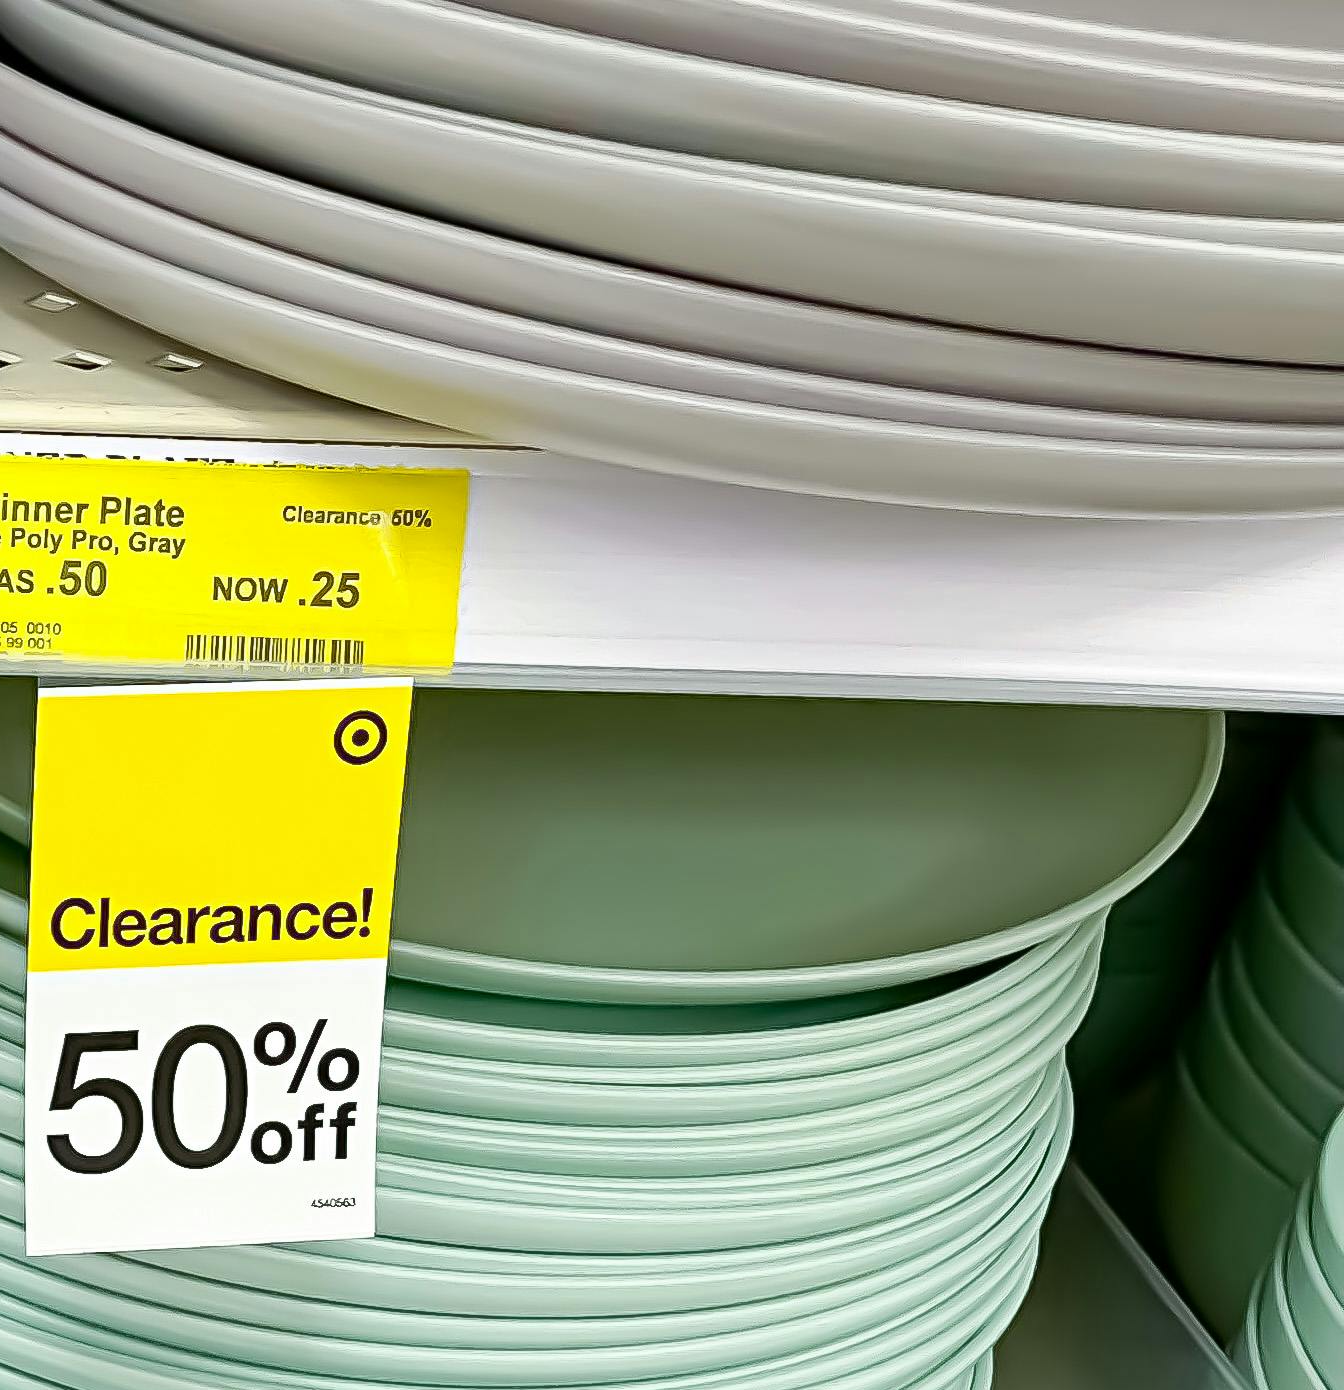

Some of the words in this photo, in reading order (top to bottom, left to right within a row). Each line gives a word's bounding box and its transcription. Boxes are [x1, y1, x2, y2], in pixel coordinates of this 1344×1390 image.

[99, 496, 186, 528] Plate
[282, 505, 381, 526] Clearance
[10, 528, 64, 555] Poly
[71, 529, 120, 556] Pro,
[128, 531, 187, 560] Gray
[46, 560, 108, 597] .50
[212, 576, 289, 604] NOW
[298, 570, 361, 609] .25
[0, 621, 18, 634] 05
[26, 621, 62, 635] 0010
[49, 887, 375, 950] Clearance!
[45, 1019, 361, 1174] 50%
[249, 1101, 357, 1165] off
